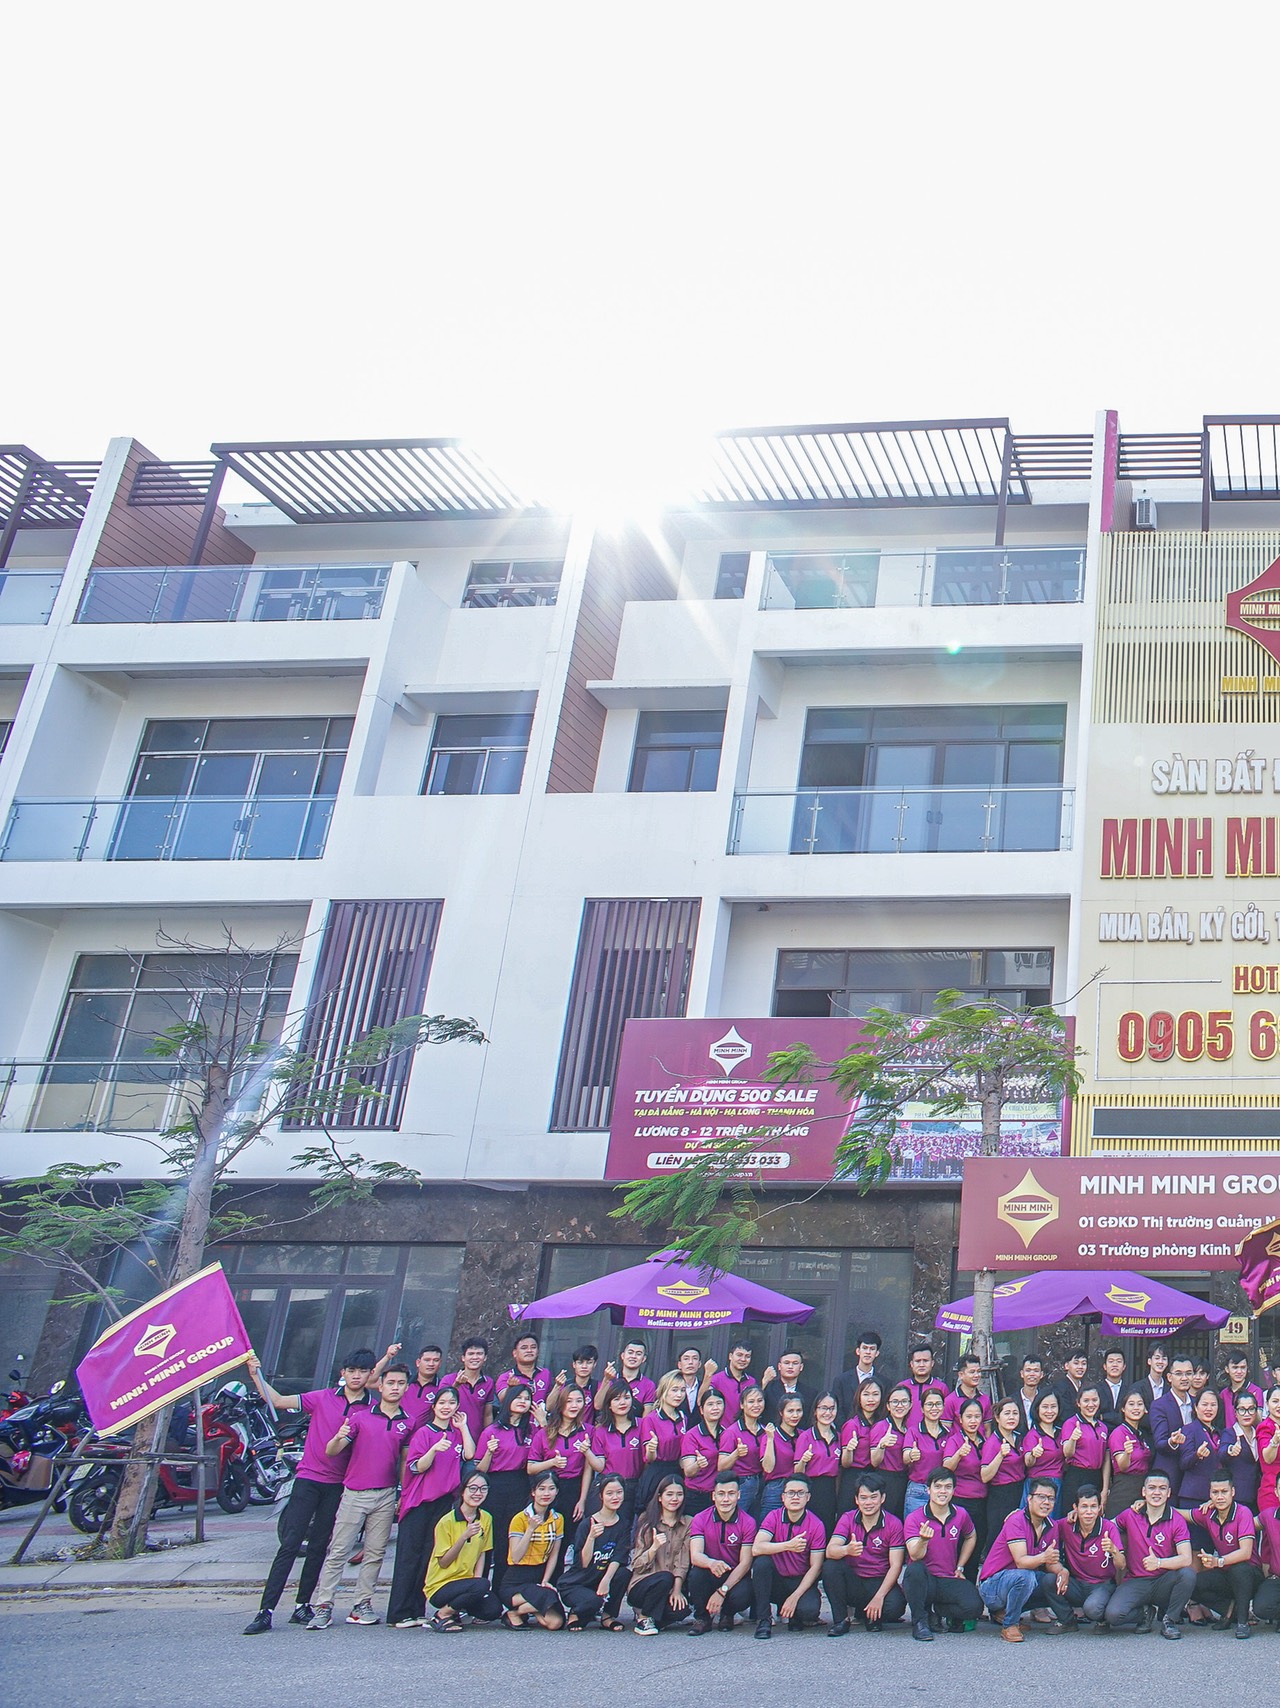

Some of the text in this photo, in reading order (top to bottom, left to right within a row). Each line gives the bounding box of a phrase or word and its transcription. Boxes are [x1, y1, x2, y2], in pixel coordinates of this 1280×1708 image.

[1240, 604, 1265, 615] MINH
[1221, 675, 1258, 694] MINH
[1151, 752, 1208, 794] SÀN
[1215, 749, 1266, 794] BẤT
[1099, 816, 1214, 878] MINH
[1099, 912, 1144, 942] MUA
[1147, 906, 1194, 945] BÁN,
[1200, 905, 1226, 942] KÝ
[1116, 1009, 1235, 1062] 0905
[634, 1084, 819, 1107] TUYỂN DỤNG 500 SALE
[634, 1109, 648, 1117] TẠI
[690, 1107, 702, 1116] HÀ
[703, 1106, 719, 1117] NỘI
[724, 1108, 737, 1117] HẠ
[737, 1108, 760, 1116] LONG
[767, 1108, 796, 1116] THANH
[796, 1106, 815, 1115] HÓA
[634, 1126, 679, 1137] LƯƠNG
[680, 1127, 690, 1137] 8
[700, 1127, 713, 1137] 12
[715, 1124, 752, 1139] TRIỆU
[655, 1154, 782, 1165] LIÊN 033
[1080, 1175, 1144, 1195] MINH
[1151, 1175, 1216, 1194] MINH
[1079, 1216, 1095, 1228] 01
[1097, 1216, 1138, 1228] GĐKD
[1142, 1216, 1163, 1231] Thị
[1166, 1215, 1213, 1231] trường
[1216, 1214, 1262, 1231] Quảng
[1078, 1244, 1096, 1256] 03
[1099, 1243, 1149, 1259] Trưởng
[1152, 1243, 1197, 1259] phòng
[1200, 1243, 1231, 1255] Kinh
[656, 1309, 678, 1318] MINH
[680, 1310, 702, 1318] MINH
[703, 1310, 732, 1318] GROUP
[1128, 1317, 1147, 1325] MINH
[1148, 1317, 1167, 1325] MINH
[647, 1319, 674, 1327] Hotline:
[1225, 1321, 1244, 1334] 49
[109, 1336, 235, 1411] MINH MINH GROUP
